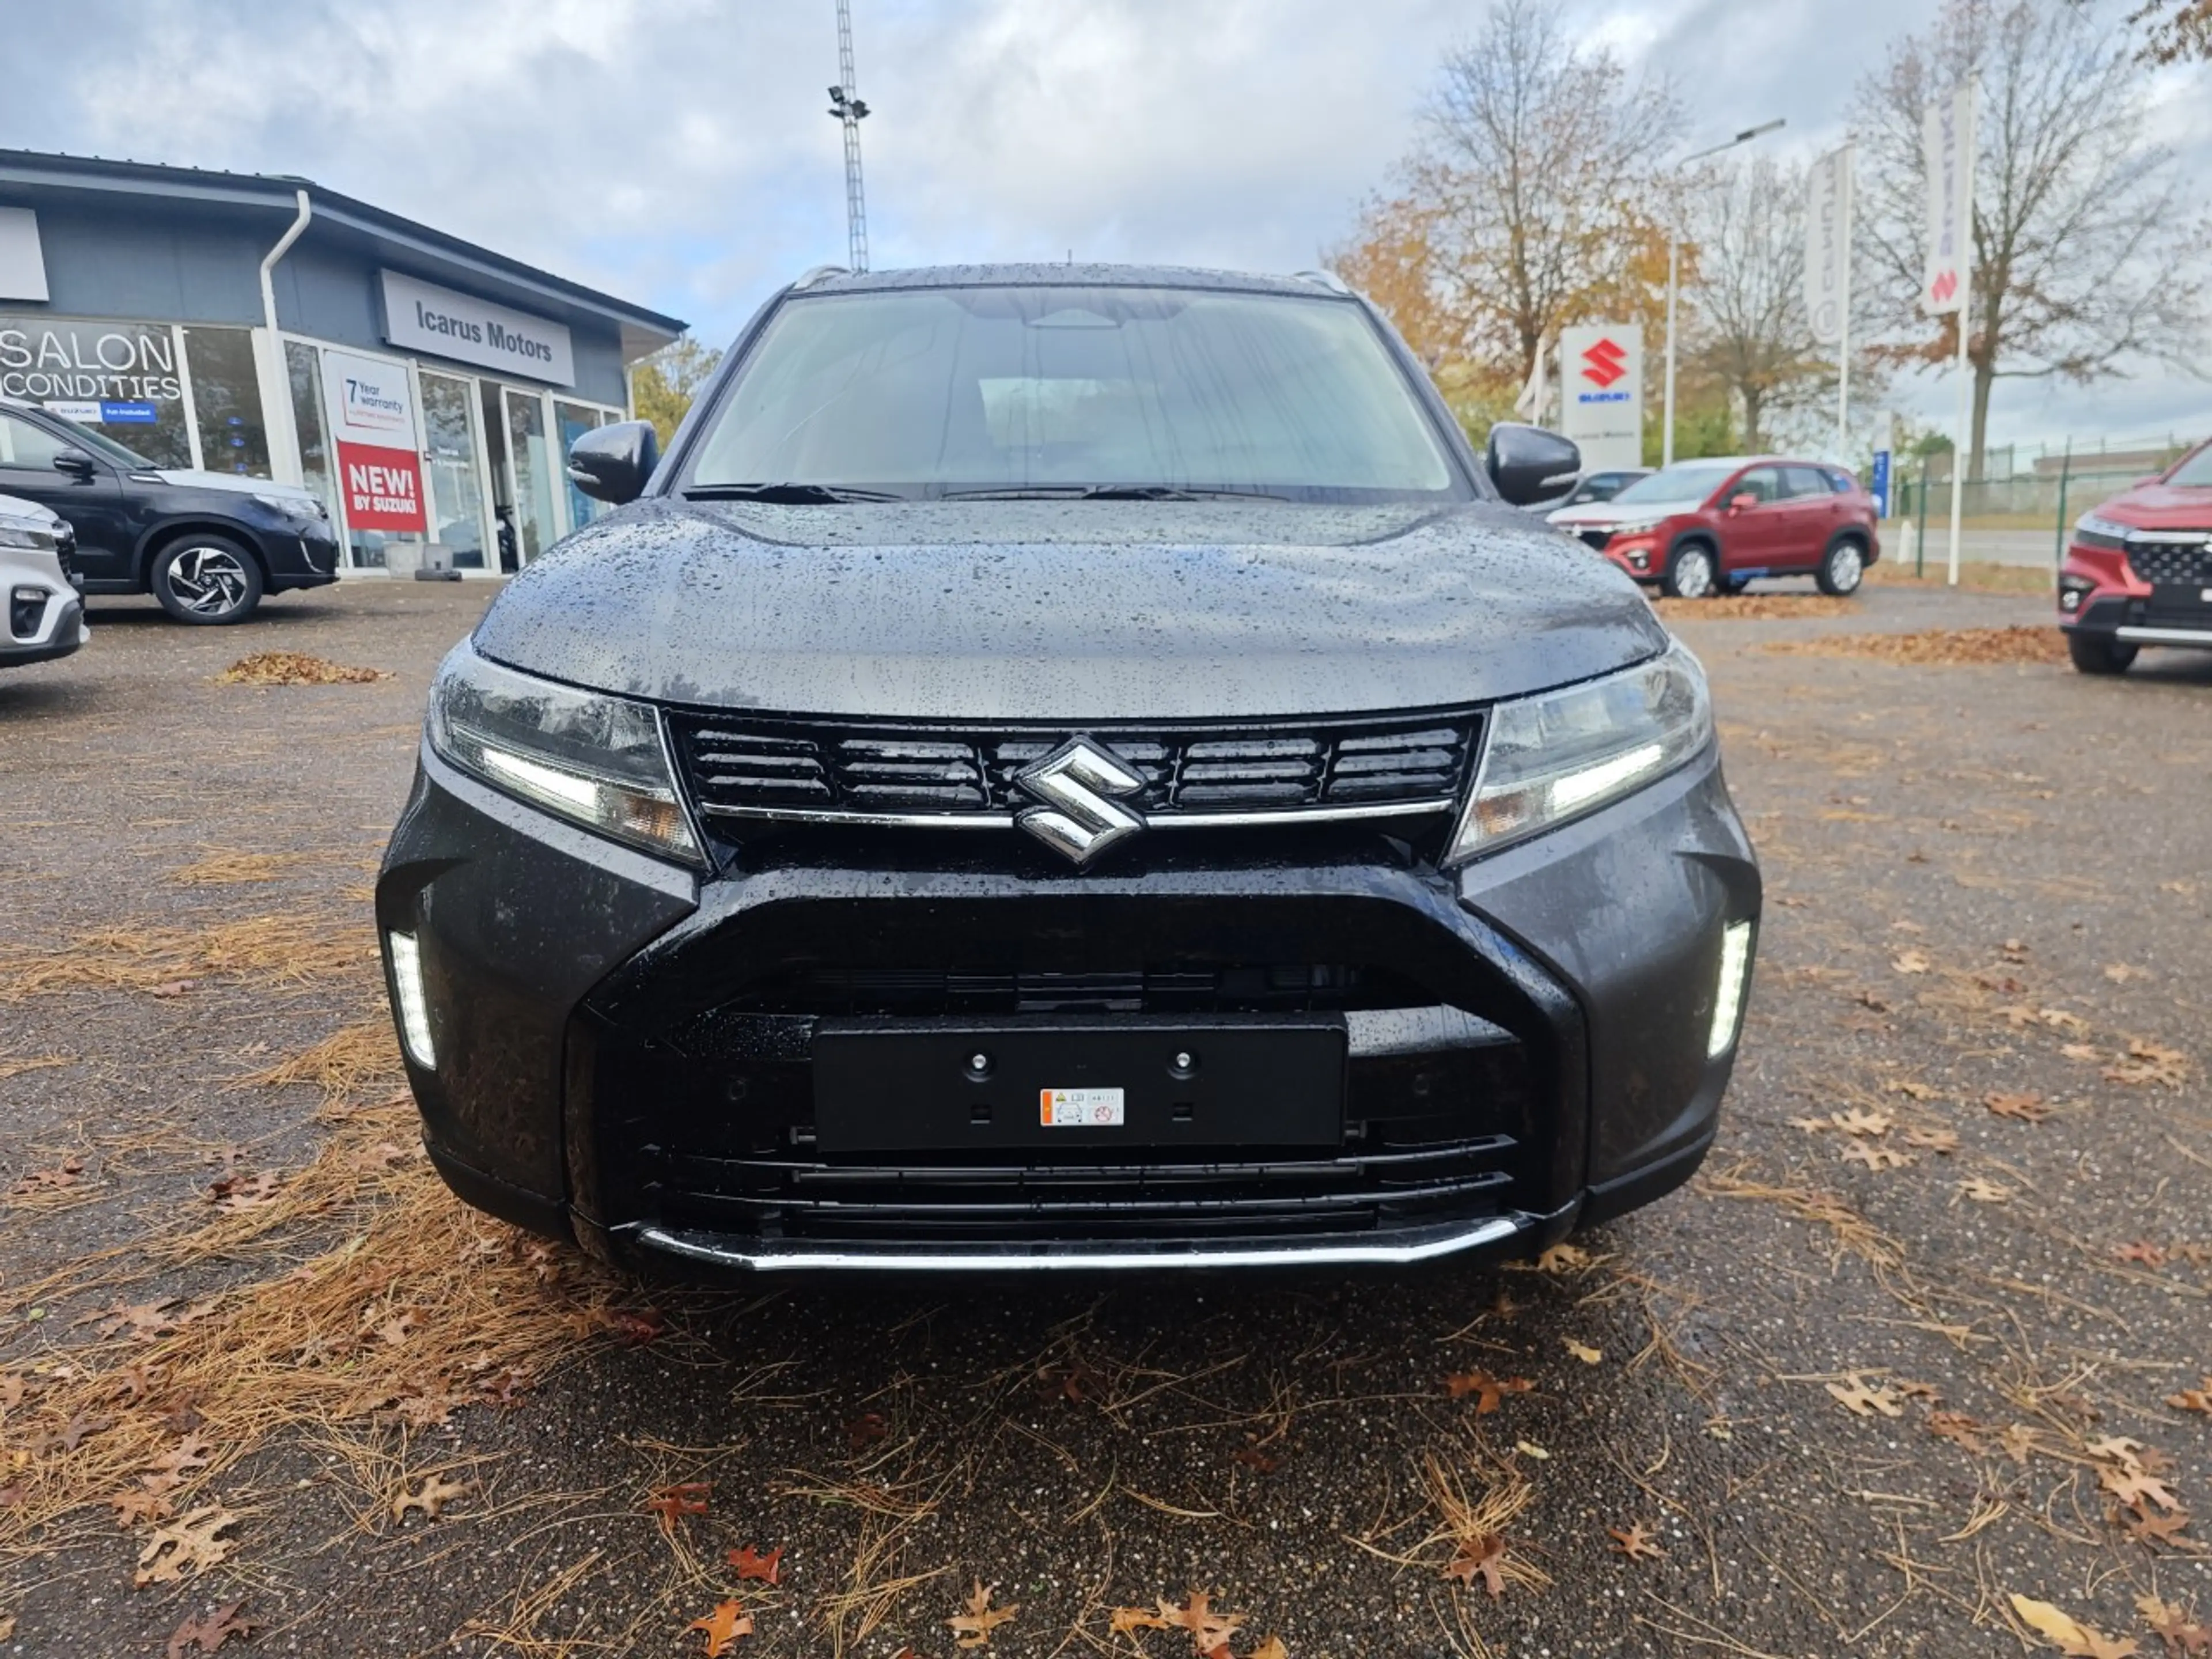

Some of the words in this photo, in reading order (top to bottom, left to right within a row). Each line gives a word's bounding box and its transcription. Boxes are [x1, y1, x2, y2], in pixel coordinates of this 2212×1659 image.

[416, 300, 482, 343] Icarus
[487, 321, 552, 362] Motors
[0, 329, 173, 373] SALON
[2, 372, 181, 400] CONDITIES
[346, 378, 357, 403] 7
[358, 381, 380, 395] Year
[359, 396, 403, 414] warranty
[349, 463, 415, 499] NEW!
[353, 494, 370, 511] BY
[373, 496, 417, 514] SUZUKI
